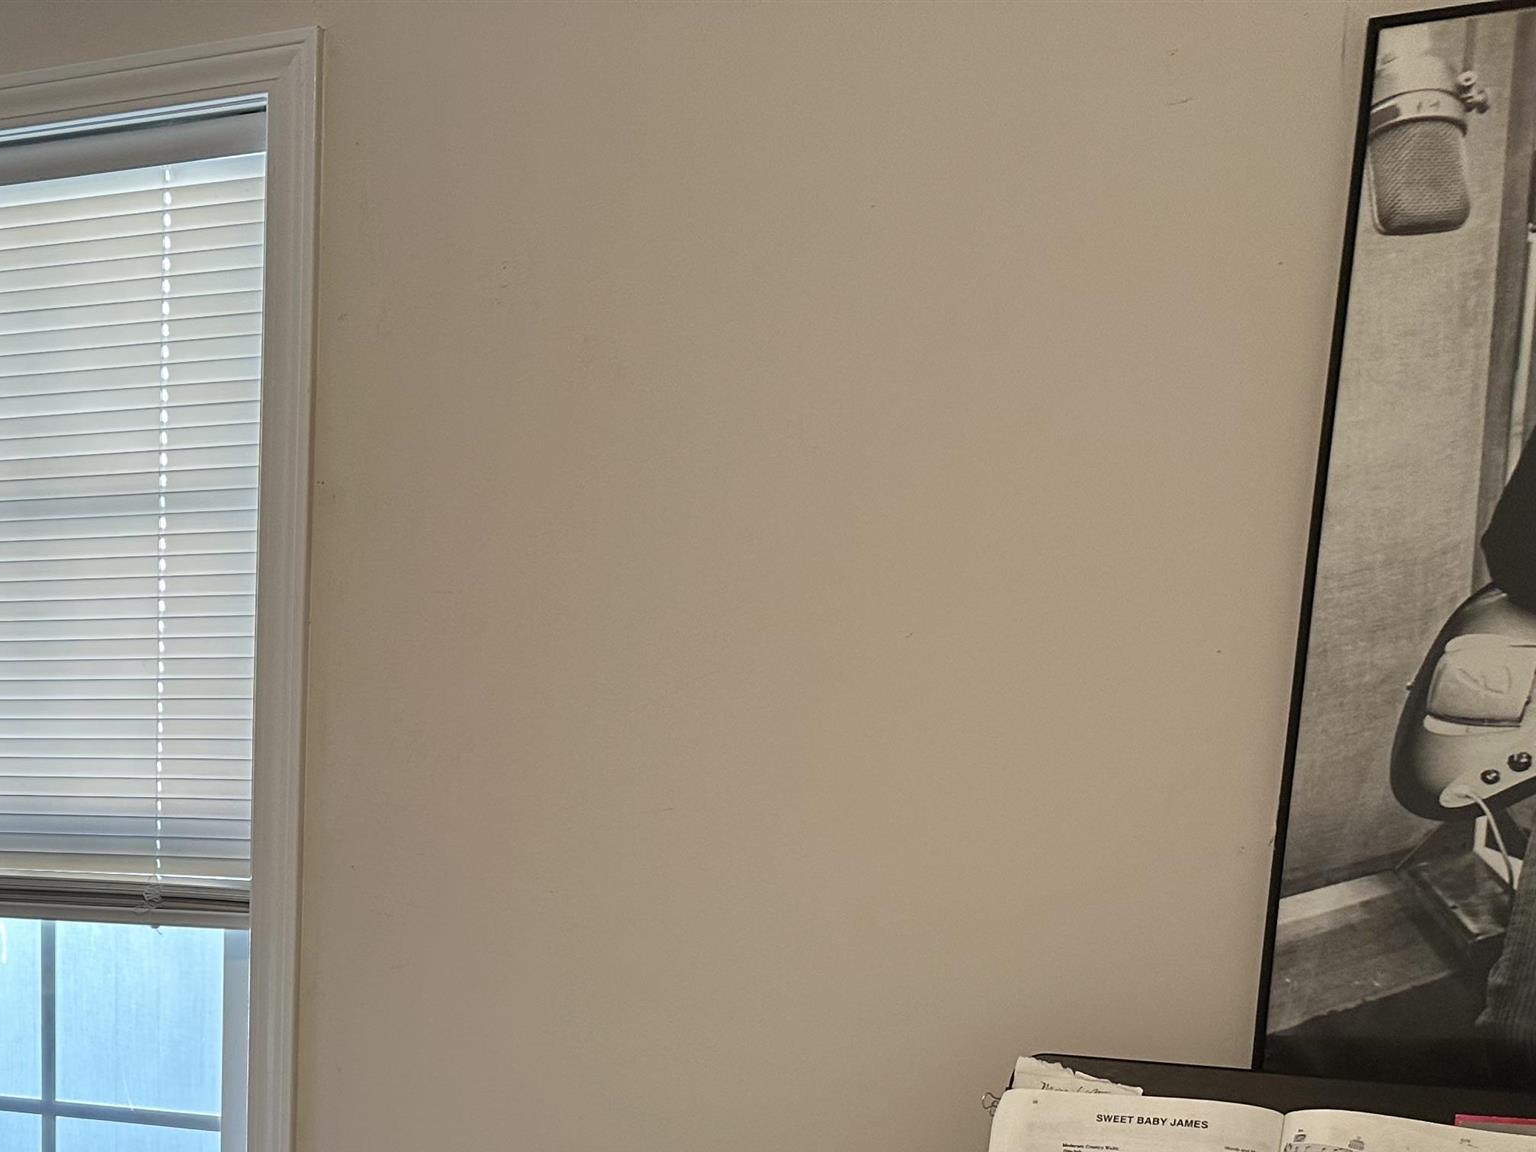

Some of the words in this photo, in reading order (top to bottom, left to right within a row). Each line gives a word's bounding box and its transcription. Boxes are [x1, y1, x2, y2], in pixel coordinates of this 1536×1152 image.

[1095, 1113, 1135, 1125] SWEET
[1137, 1115, 1168, 1127] BABY
[1170, 1118, 1209, 1130] JAMES
